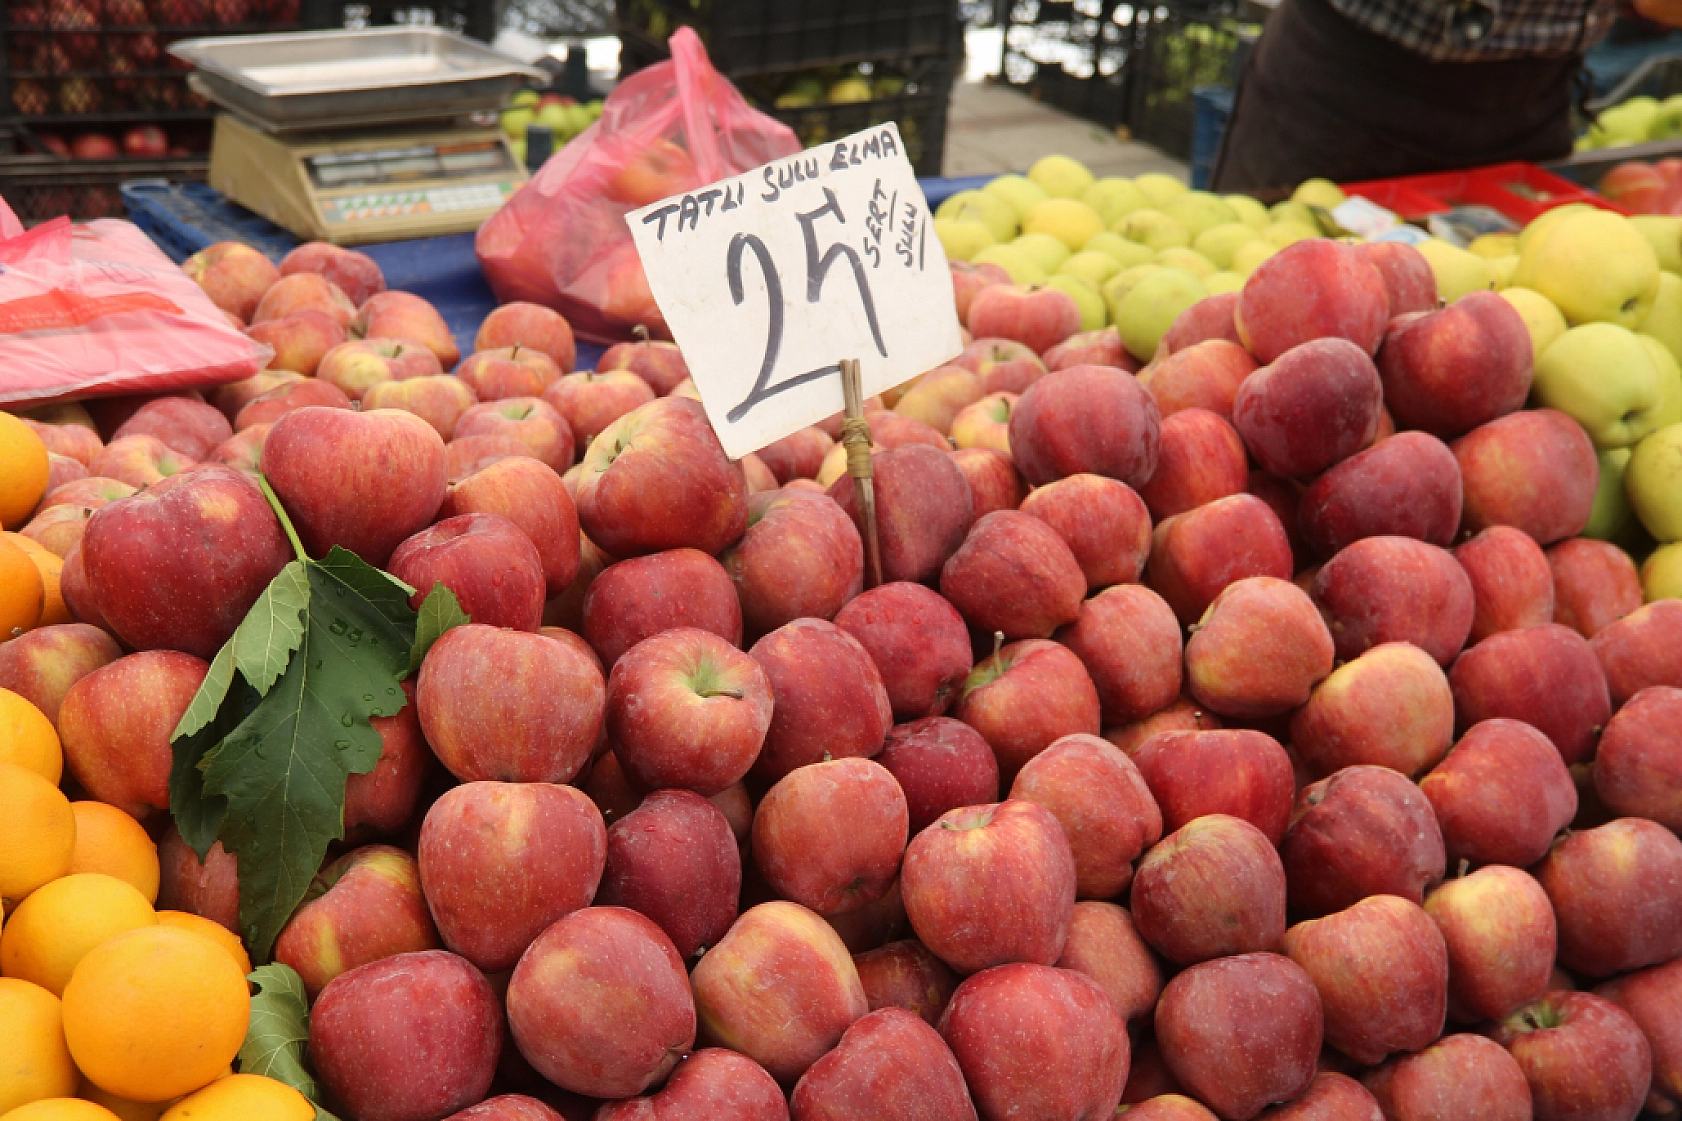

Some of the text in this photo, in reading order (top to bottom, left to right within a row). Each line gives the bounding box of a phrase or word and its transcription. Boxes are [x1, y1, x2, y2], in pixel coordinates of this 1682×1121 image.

[642, 129, 898, 241] TATLI SULU ELMA
[863, 177, 888, 269] SERT
[896, 202, 918, 268] SULU
[726, 185, 889, 424] 25
